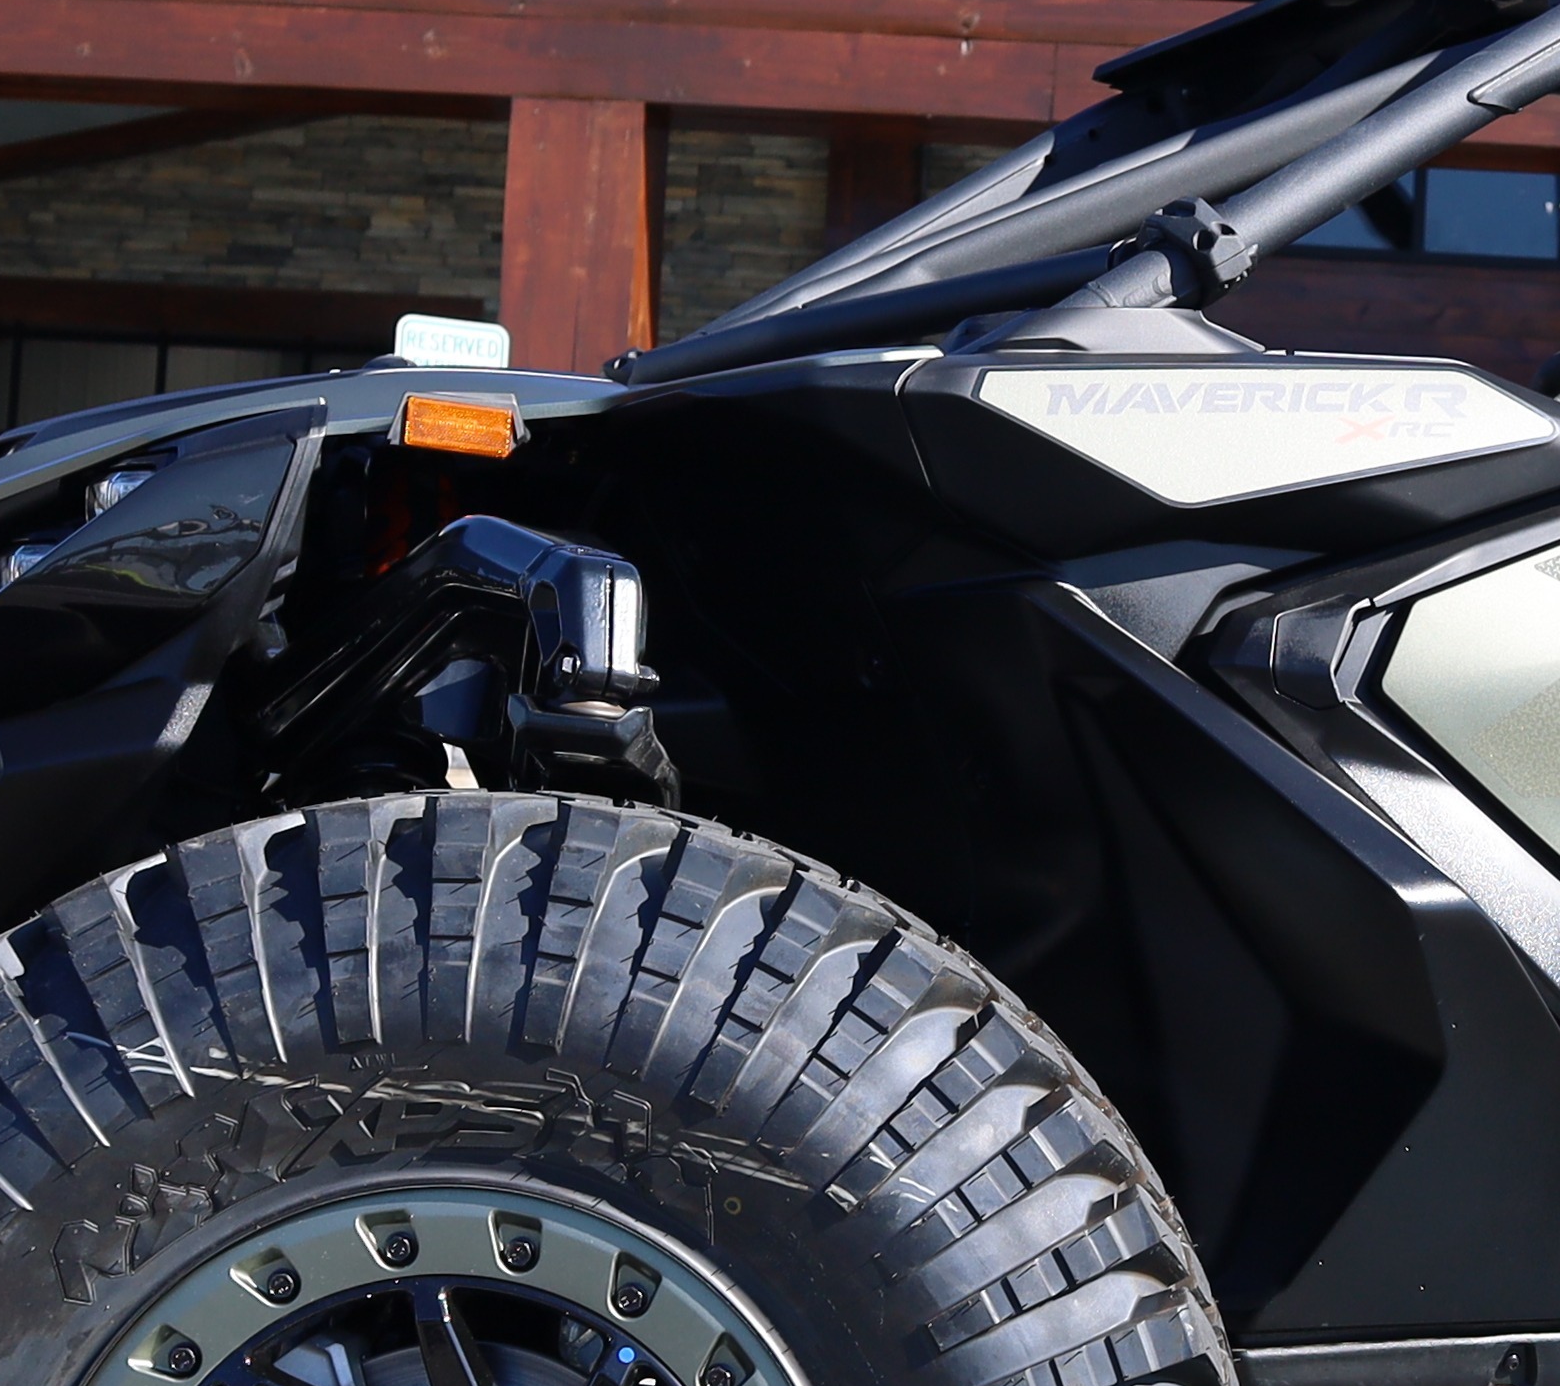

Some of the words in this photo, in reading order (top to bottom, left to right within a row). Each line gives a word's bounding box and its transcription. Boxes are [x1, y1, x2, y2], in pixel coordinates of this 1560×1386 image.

[406, 329, 498, 359] RESERVED
[1045, 381, 1397, 416] MAVERICK
[1403, 382, 1468, 420] R
[1334, 414, 1457, 445] XRC
